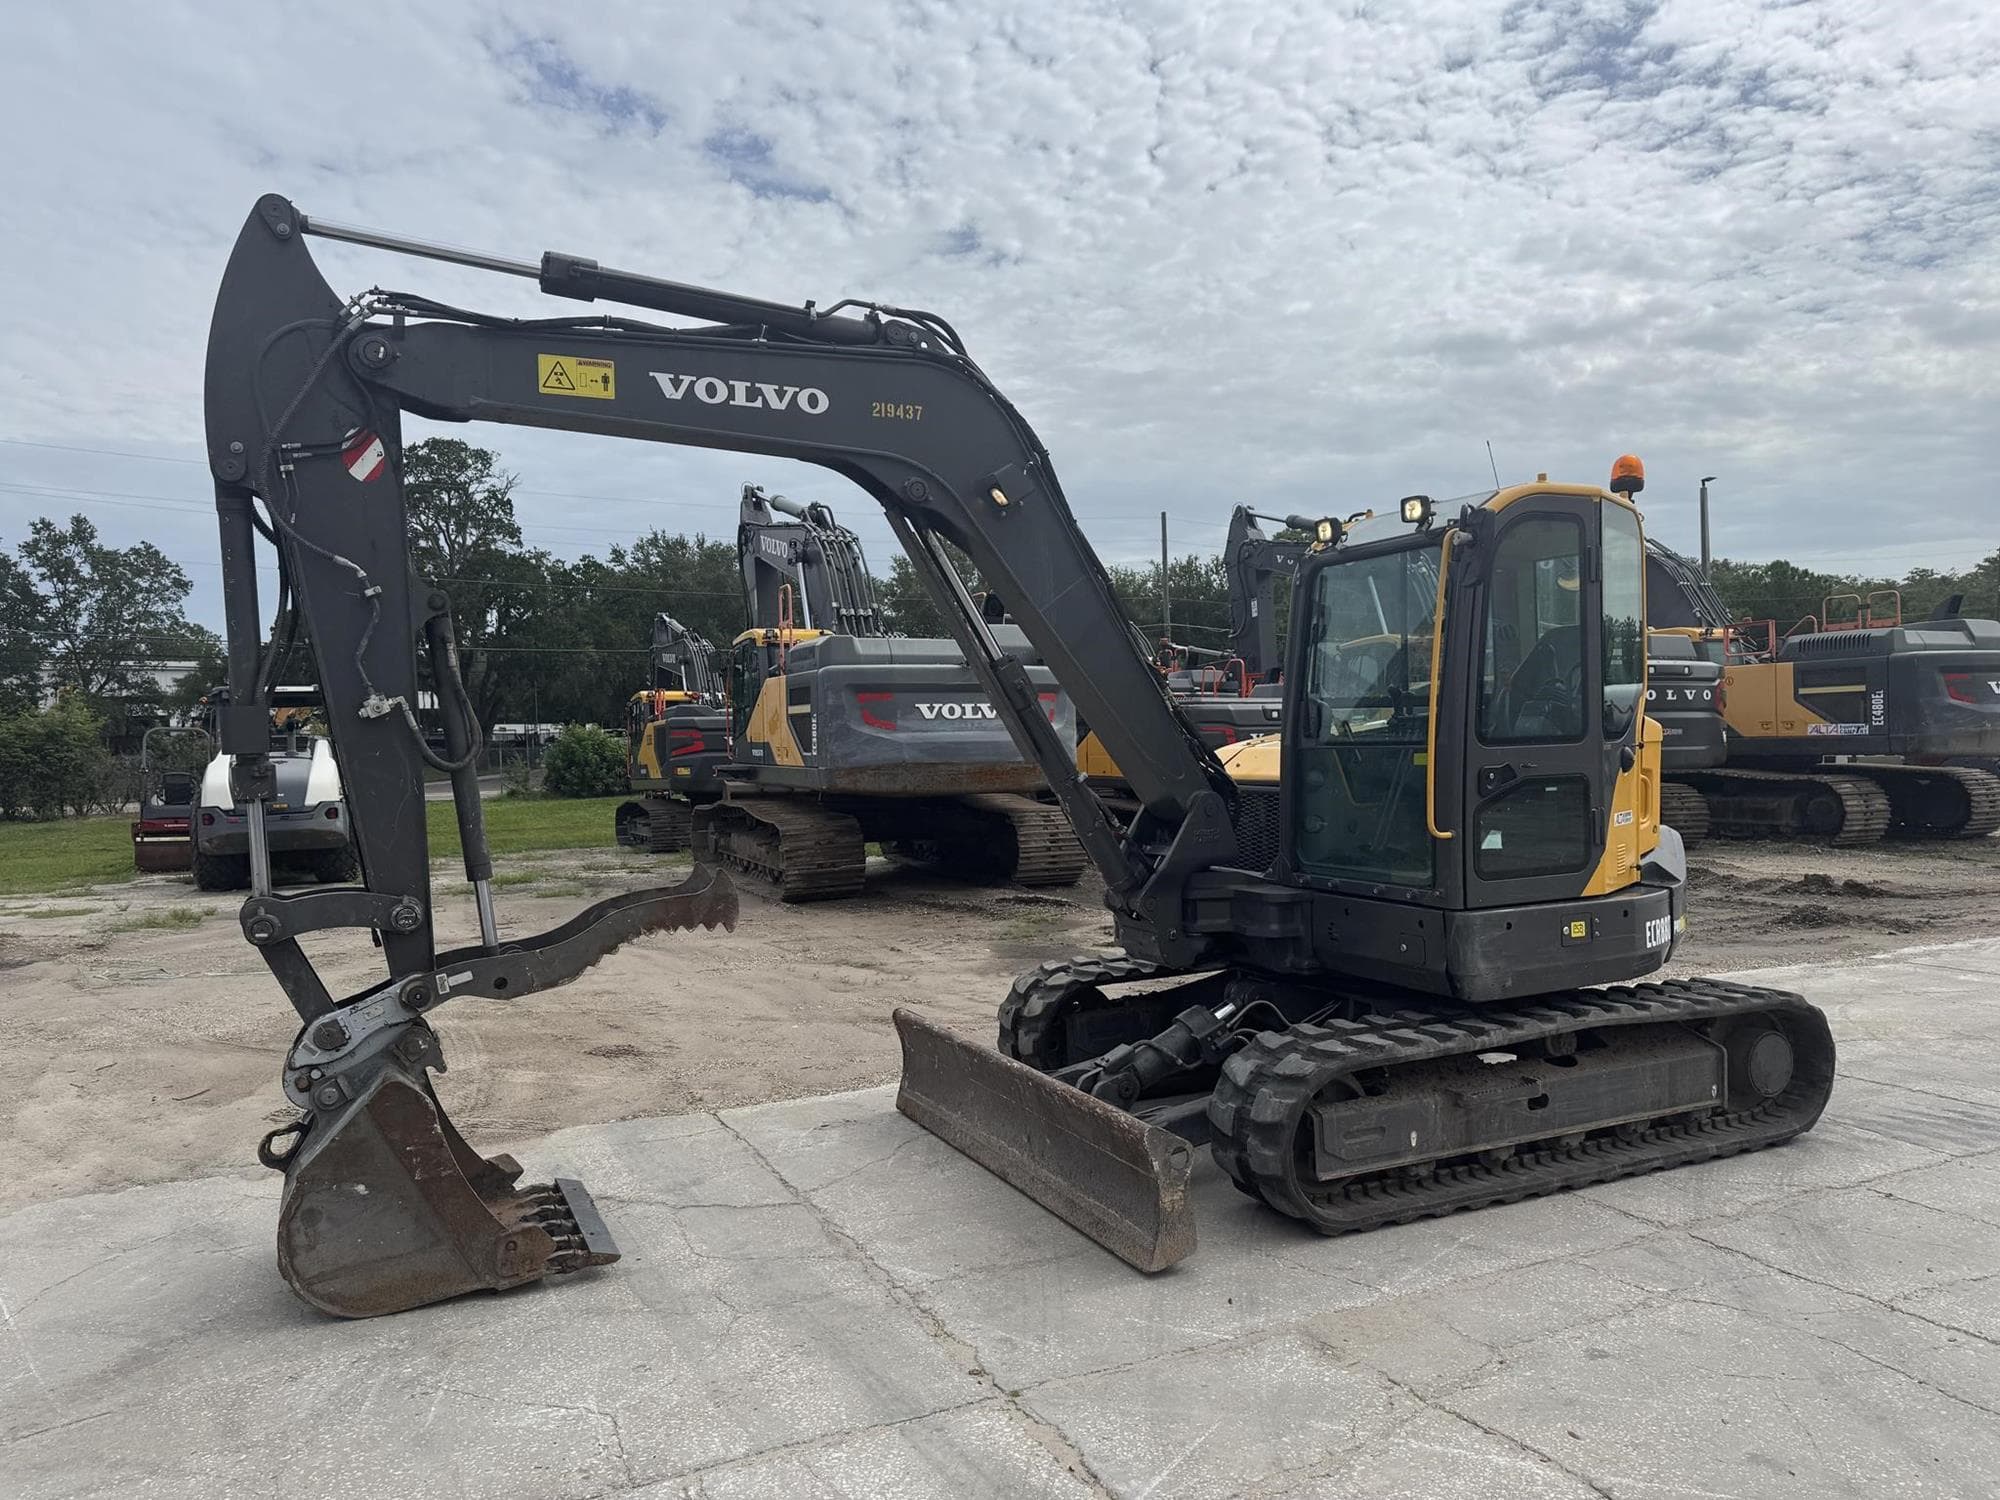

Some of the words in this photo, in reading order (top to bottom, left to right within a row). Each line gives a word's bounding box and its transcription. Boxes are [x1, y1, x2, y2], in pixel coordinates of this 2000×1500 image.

[649, 371, 830, 415] VOLVO
[871, 402, 923, 421] 219437
[760, 535, 788, 558] VOLVO
[1646, 689, 1712, 700] OLVO
[915, 703, 997, 719] VOLV
